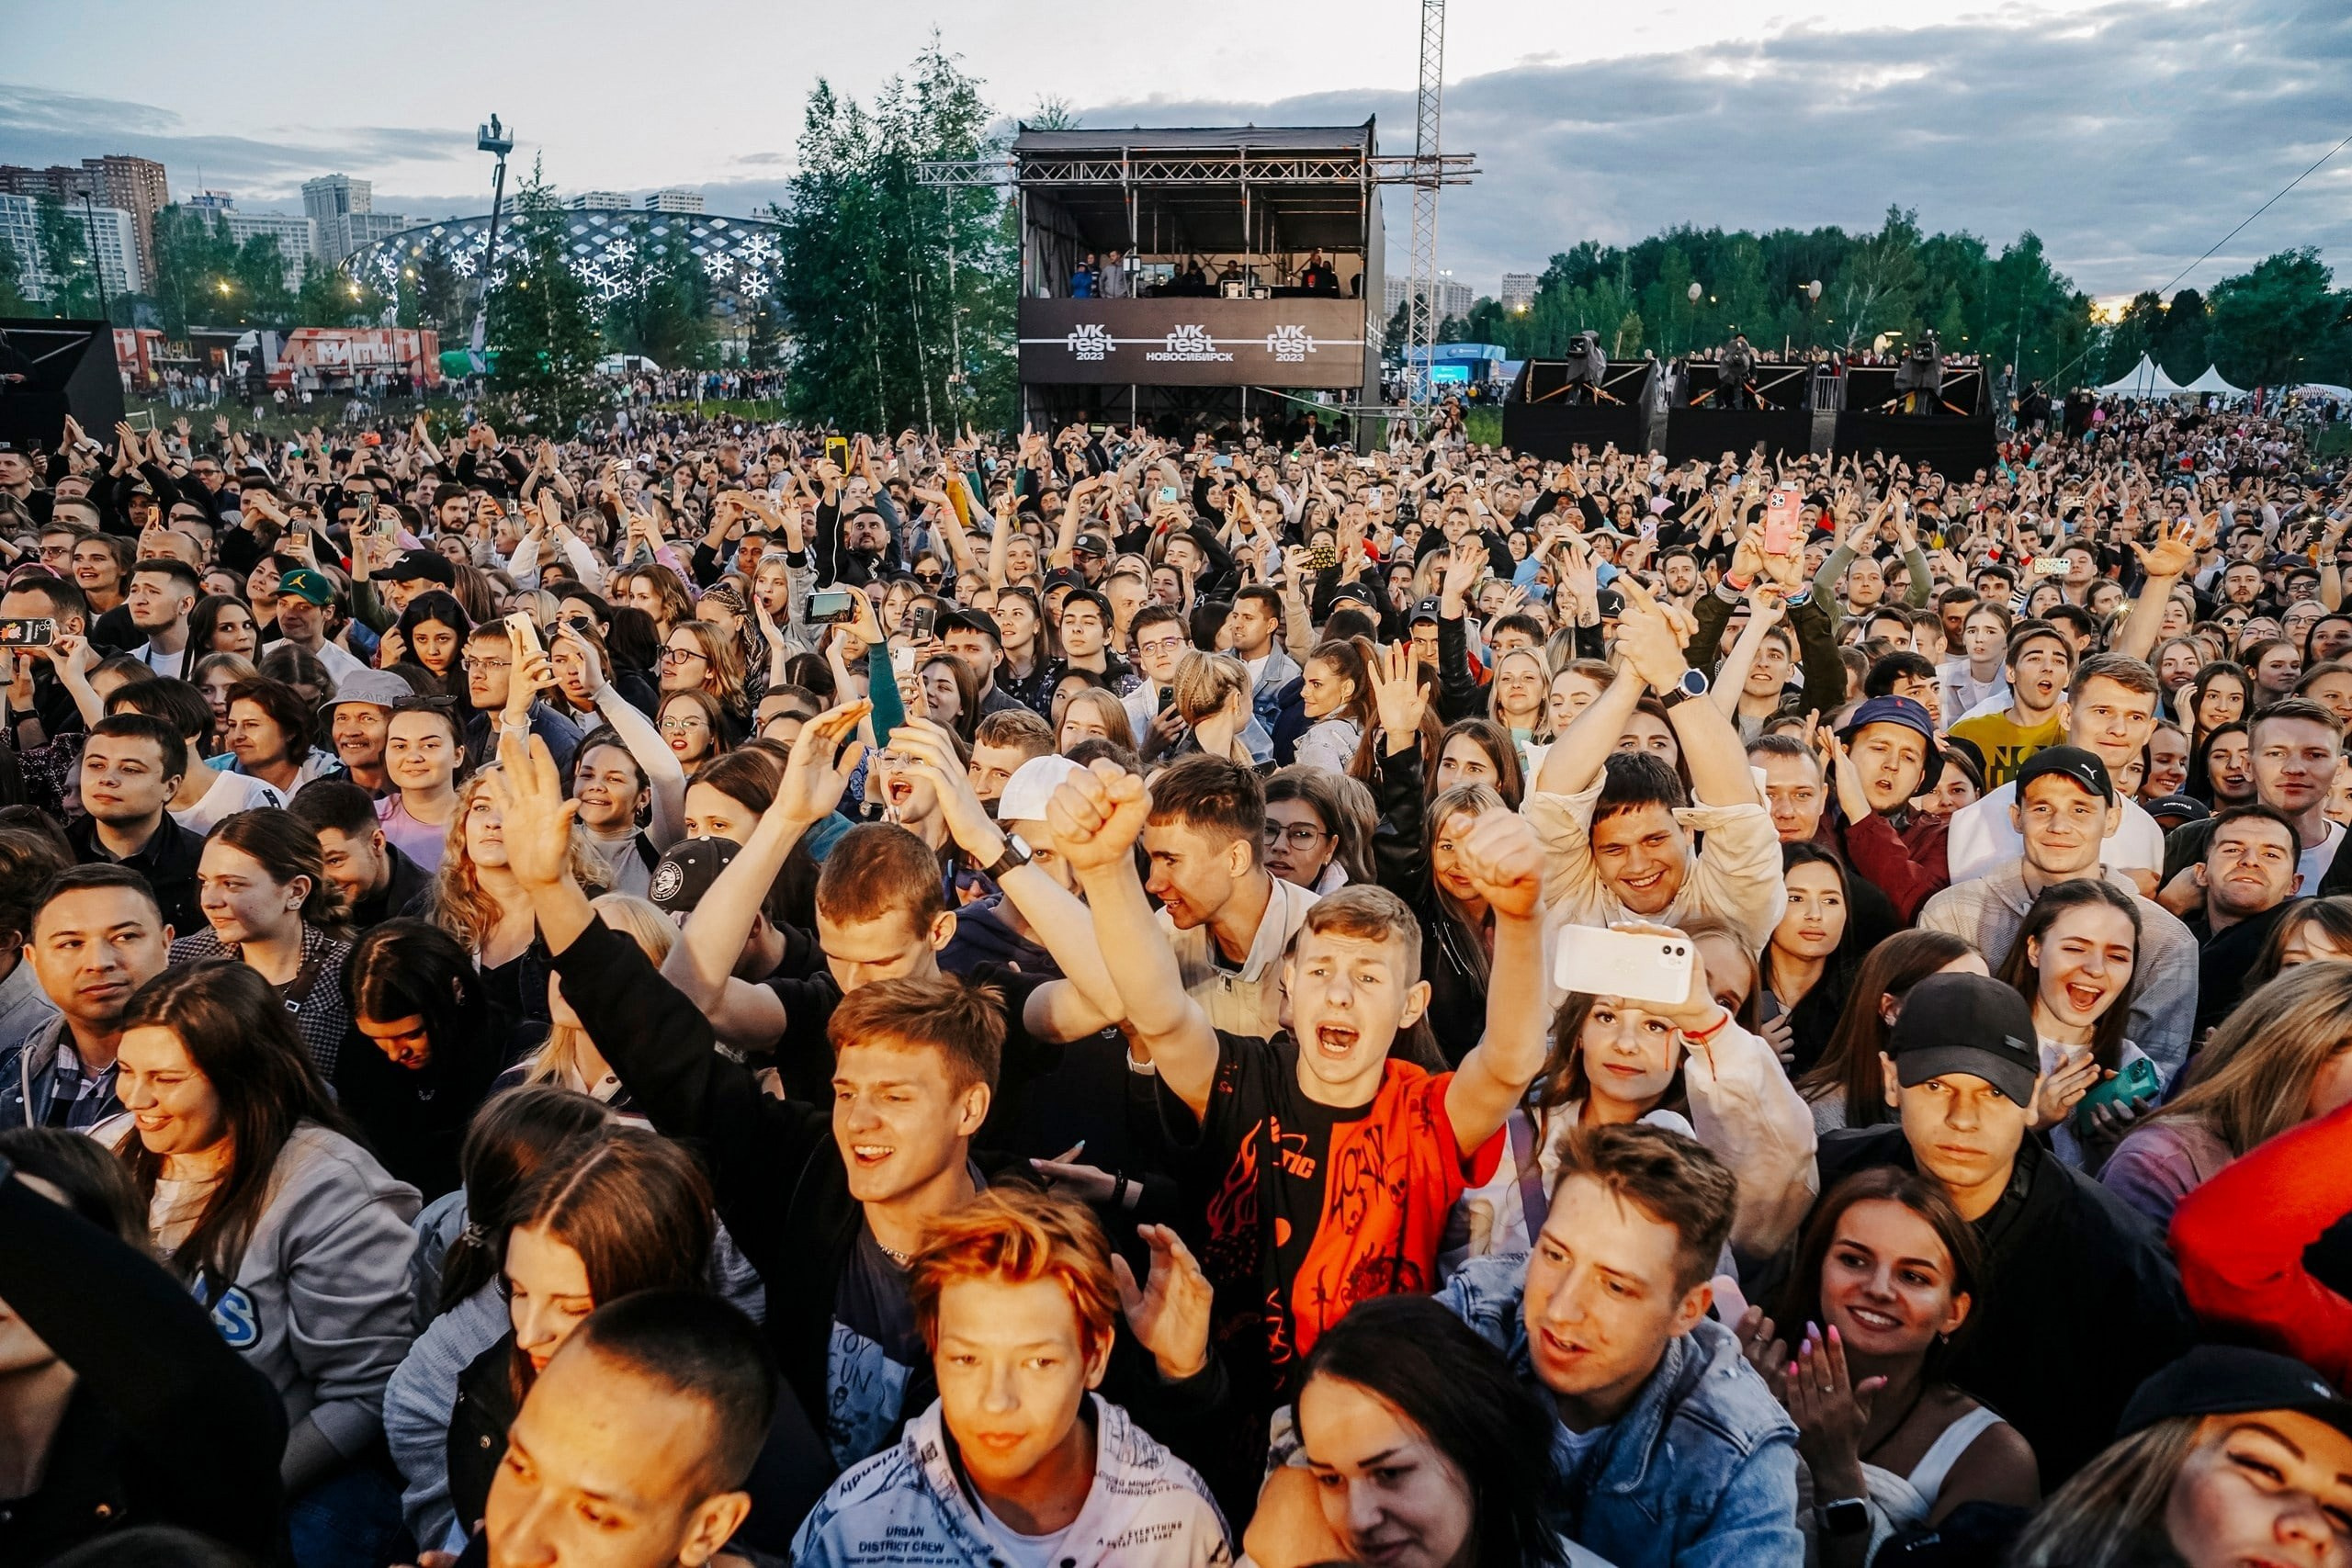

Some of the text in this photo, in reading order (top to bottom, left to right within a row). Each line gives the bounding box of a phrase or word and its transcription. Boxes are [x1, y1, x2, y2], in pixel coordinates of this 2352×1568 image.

[1075, 324, 1105, 337] VK
[1174, 324, 1204, 338] VK
[1275, 324, 1306, 339] VK
[1068, 333, 1116, 352] fest
[1166, 333, 1216, 353] fest
[1267, 333, 1317, 354] fest
[1076, 352, 1105, 361] 2023
[1146, 353, 1234, 362] НОВОСИБИРСК
[1275, 353, 1305, 362] 2023
[886, 1525, 925, 1538] URBAN
[858, 1540, 945, 1553] DISTRICT CREW
